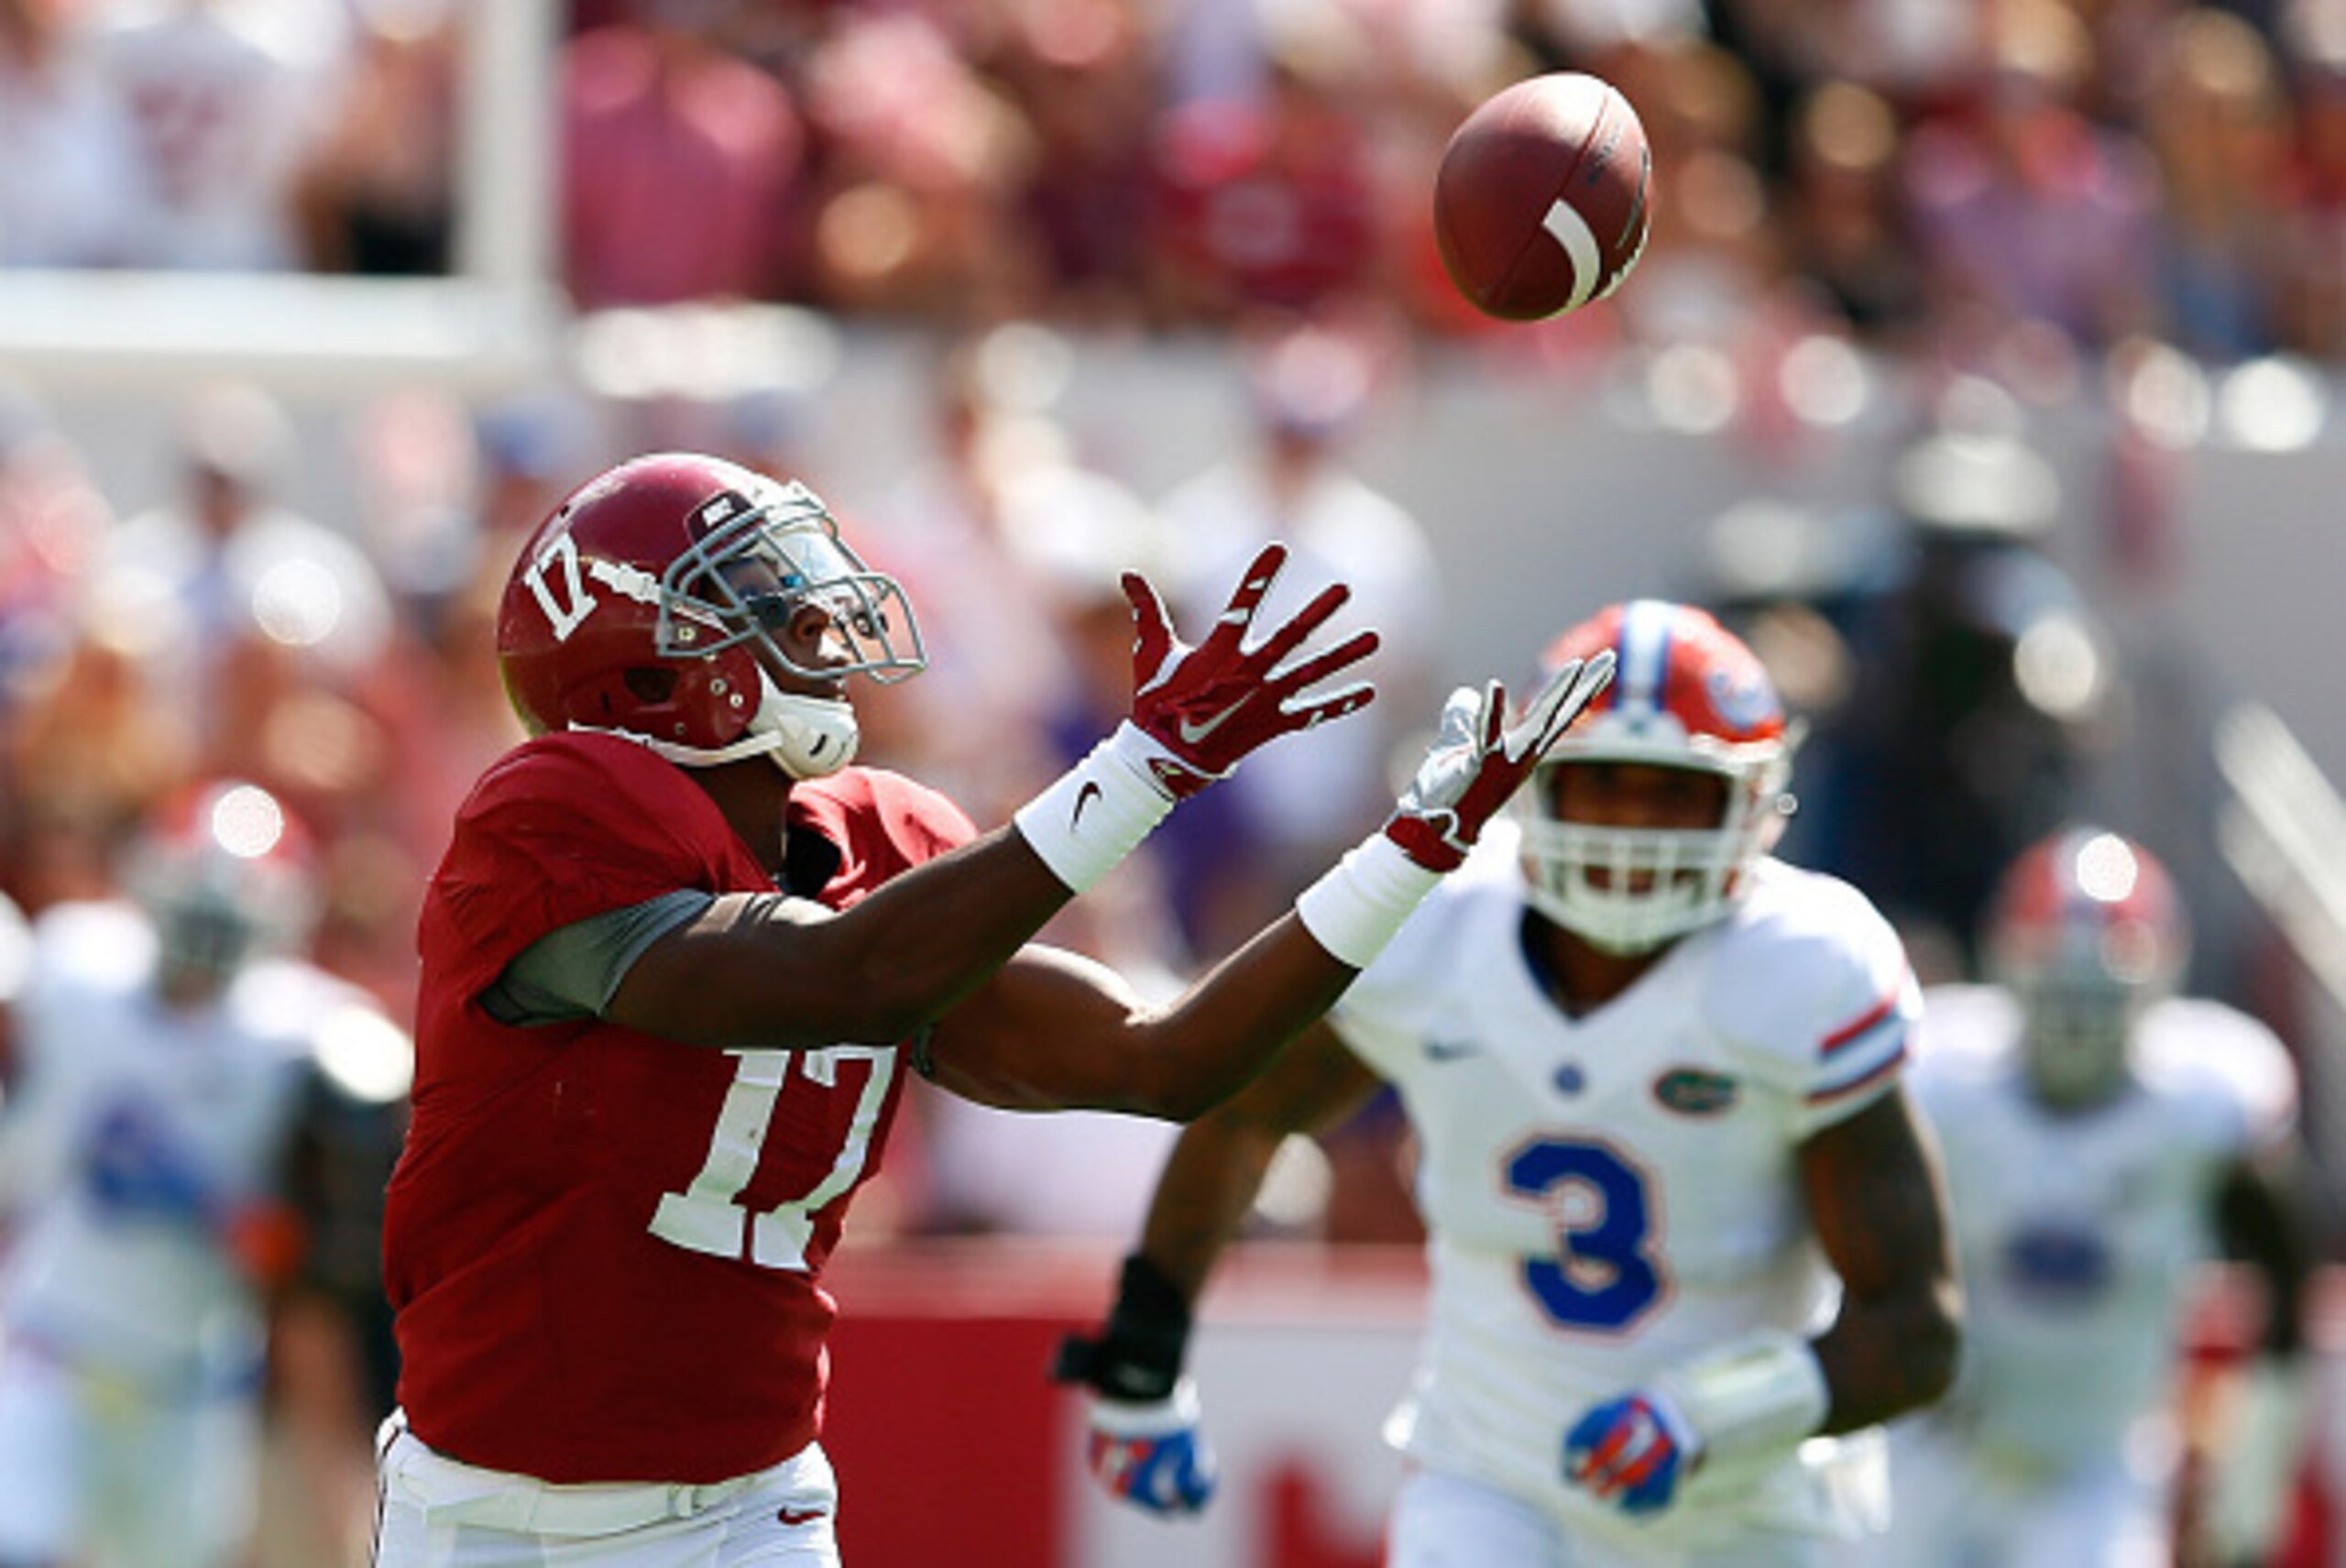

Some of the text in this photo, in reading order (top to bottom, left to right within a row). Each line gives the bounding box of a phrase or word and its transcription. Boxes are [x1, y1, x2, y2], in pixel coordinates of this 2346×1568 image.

[523, 532, 598, 643] 17
[647, 1045, 898, 1272] 17
[1501, 1133, 1672, 1334] 3
